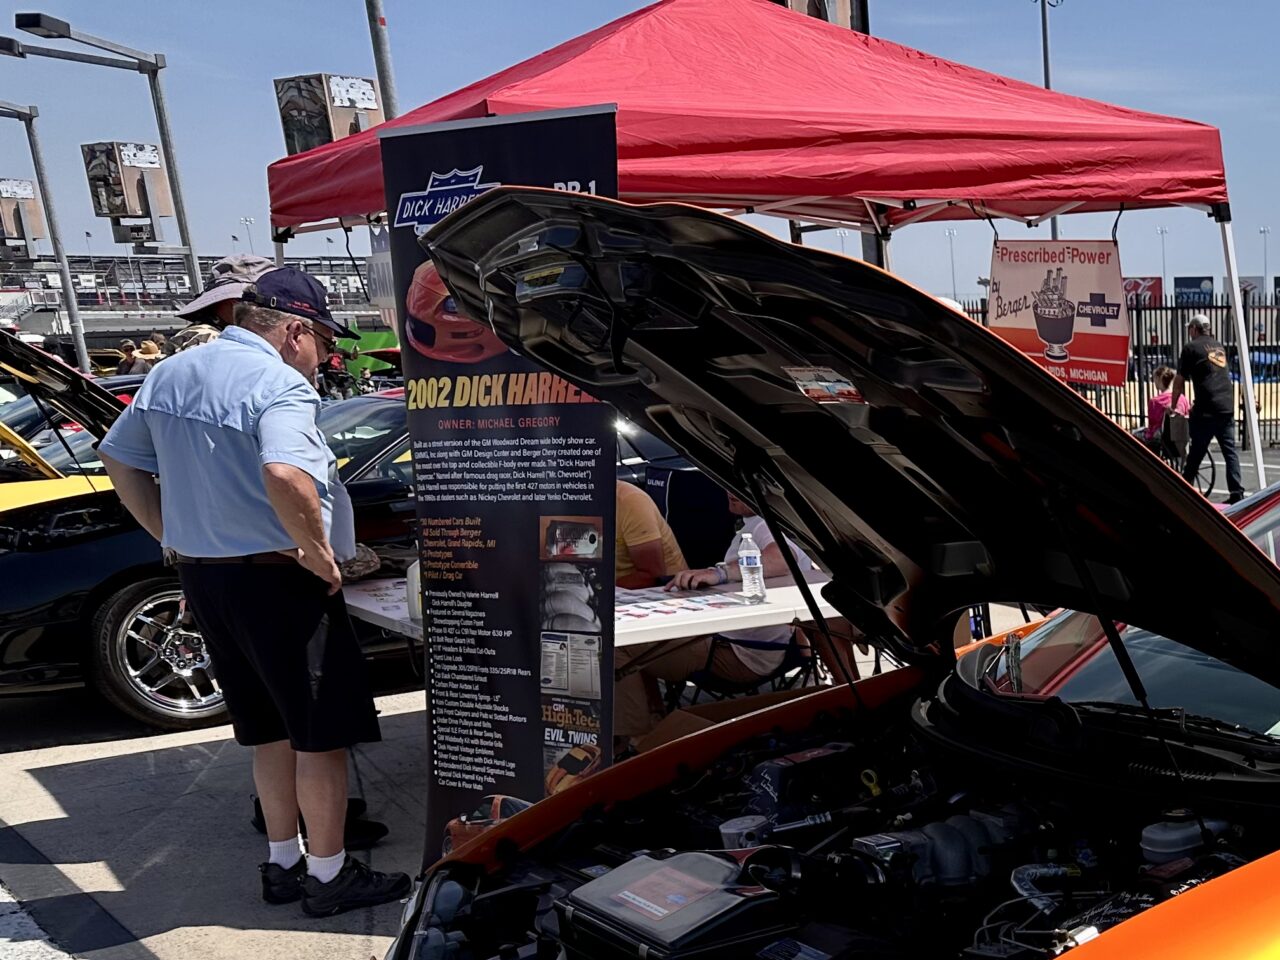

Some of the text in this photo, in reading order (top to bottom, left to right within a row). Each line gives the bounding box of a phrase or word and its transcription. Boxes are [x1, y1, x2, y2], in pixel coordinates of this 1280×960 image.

[402, 198, 433, 218] DICK
[1000, 247, 1111, 265] Prescribed Power
[1078, 305, 1118, 316] CHEVROLET
[1069, 367, 1108, 383] MICHIGAN
[407, 376, 452, 410] 2002
[452, 373, 503, 407] DICK
[438, 416, 560, 430] OWNER: MICHAEL GREGORY
[551, 437, 566, 446] body
[567, 436, 583, 444] show
[474, 450, 493, 459] Design
[522, 449, 541, 458] Berger
[541, 449, 557, 457] Chevy
[499, 460, 516, 469] F-body
[574, 459, 595, 467] Harrell
[463, 471, 485, 479] famous
[486, 472, 498, 480] drag
[479, 482, 487, 490] for
[647, 478, 665, 487] ULINE
[455, 493, 468, 501] such
[522, 493, 533, 501] and
[486, 540, 496, 548] MI
[552, 704, 565, 712] GM
[544, 727, 565, 742] EVIL
[567, 730, 598, 746] TWINS
